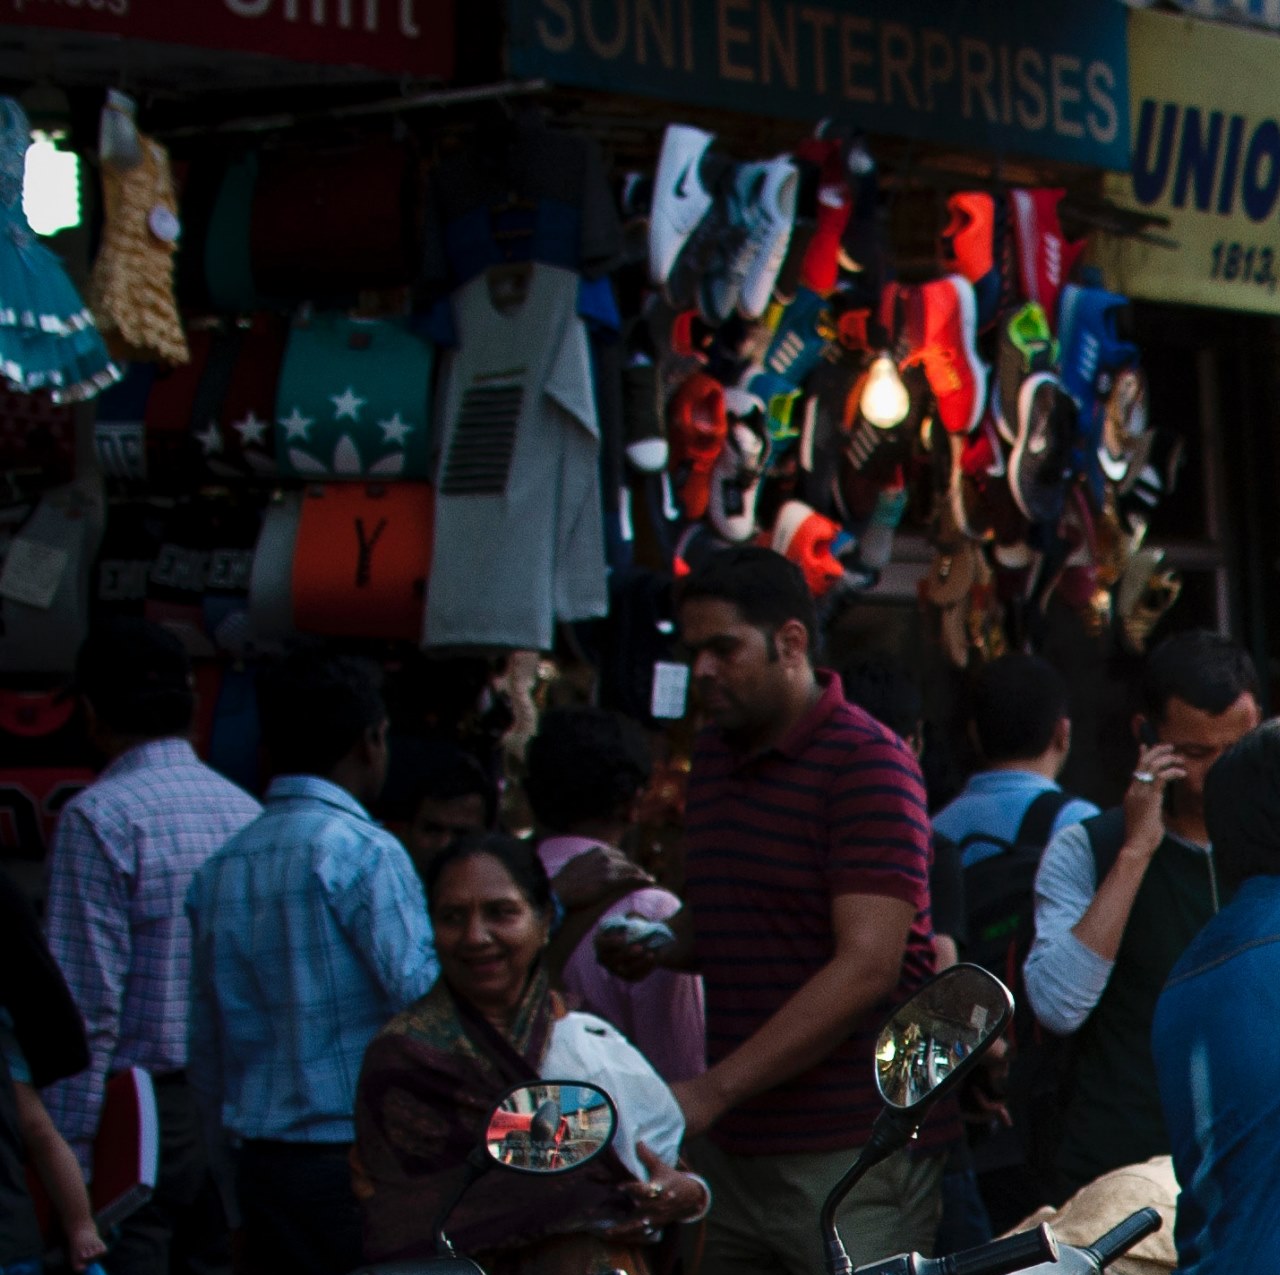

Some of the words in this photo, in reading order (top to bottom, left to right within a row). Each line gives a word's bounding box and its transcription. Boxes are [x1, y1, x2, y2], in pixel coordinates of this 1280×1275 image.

[535, 0, 697, 74] SONI
[717, 0, 1117, 145] ENTERPRISES
[1210, 240, 1277, 294] 1813,
